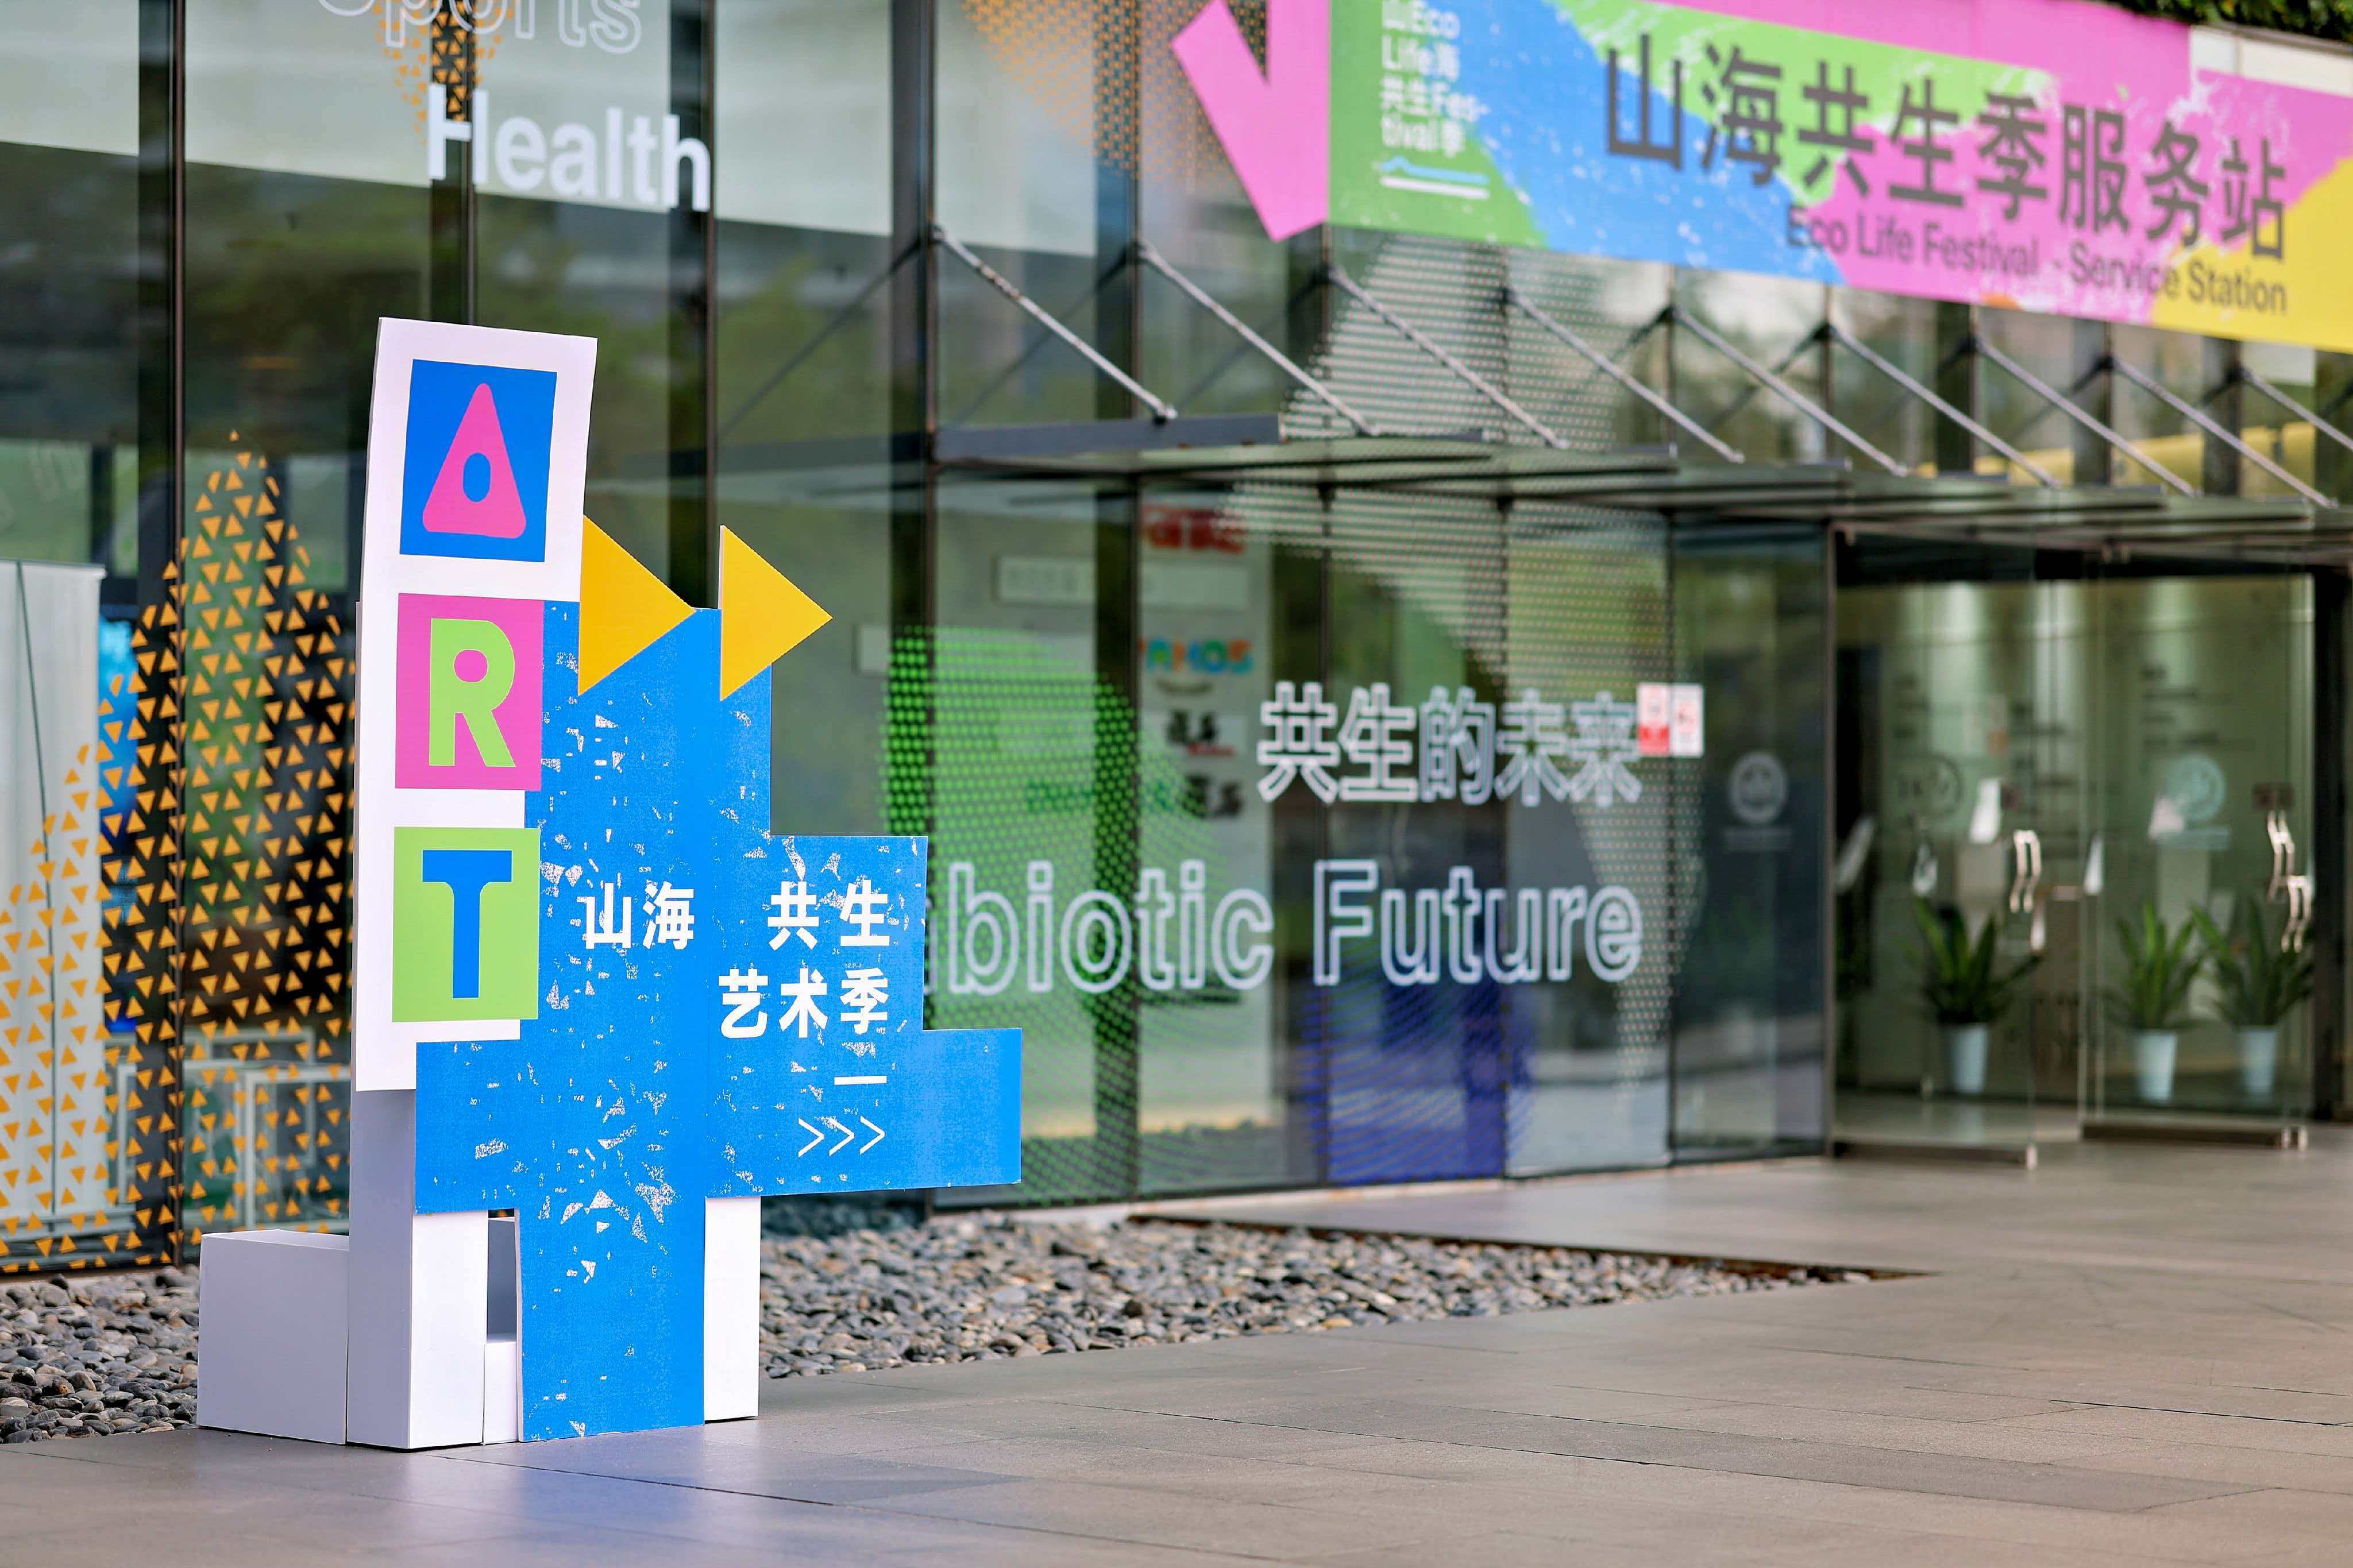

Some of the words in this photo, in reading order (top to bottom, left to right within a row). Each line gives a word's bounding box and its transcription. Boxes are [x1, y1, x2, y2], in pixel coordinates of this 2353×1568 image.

[427, 82, 711, 212] Health
[1606, 33, 2286, 262] 山海共生季服务站
[1787, 206, 1849, 254] Eco
[1858, 211, 1914, 263] Life
[1924, 221, 2038, 277] Festival
[2070, 241, 2180, 299] Service
[2188, 258, 2288, 316] Station
[1257, 682, 1643, 805] 共生的未来
[577, 882, 695, 951] 山海
[767, 880, 890, 951] 共生
[921, 860, 1274, 995] biotic
[1314, 860, 1643, 986] Future
[718, 967, 889, 1038] 艺术季
